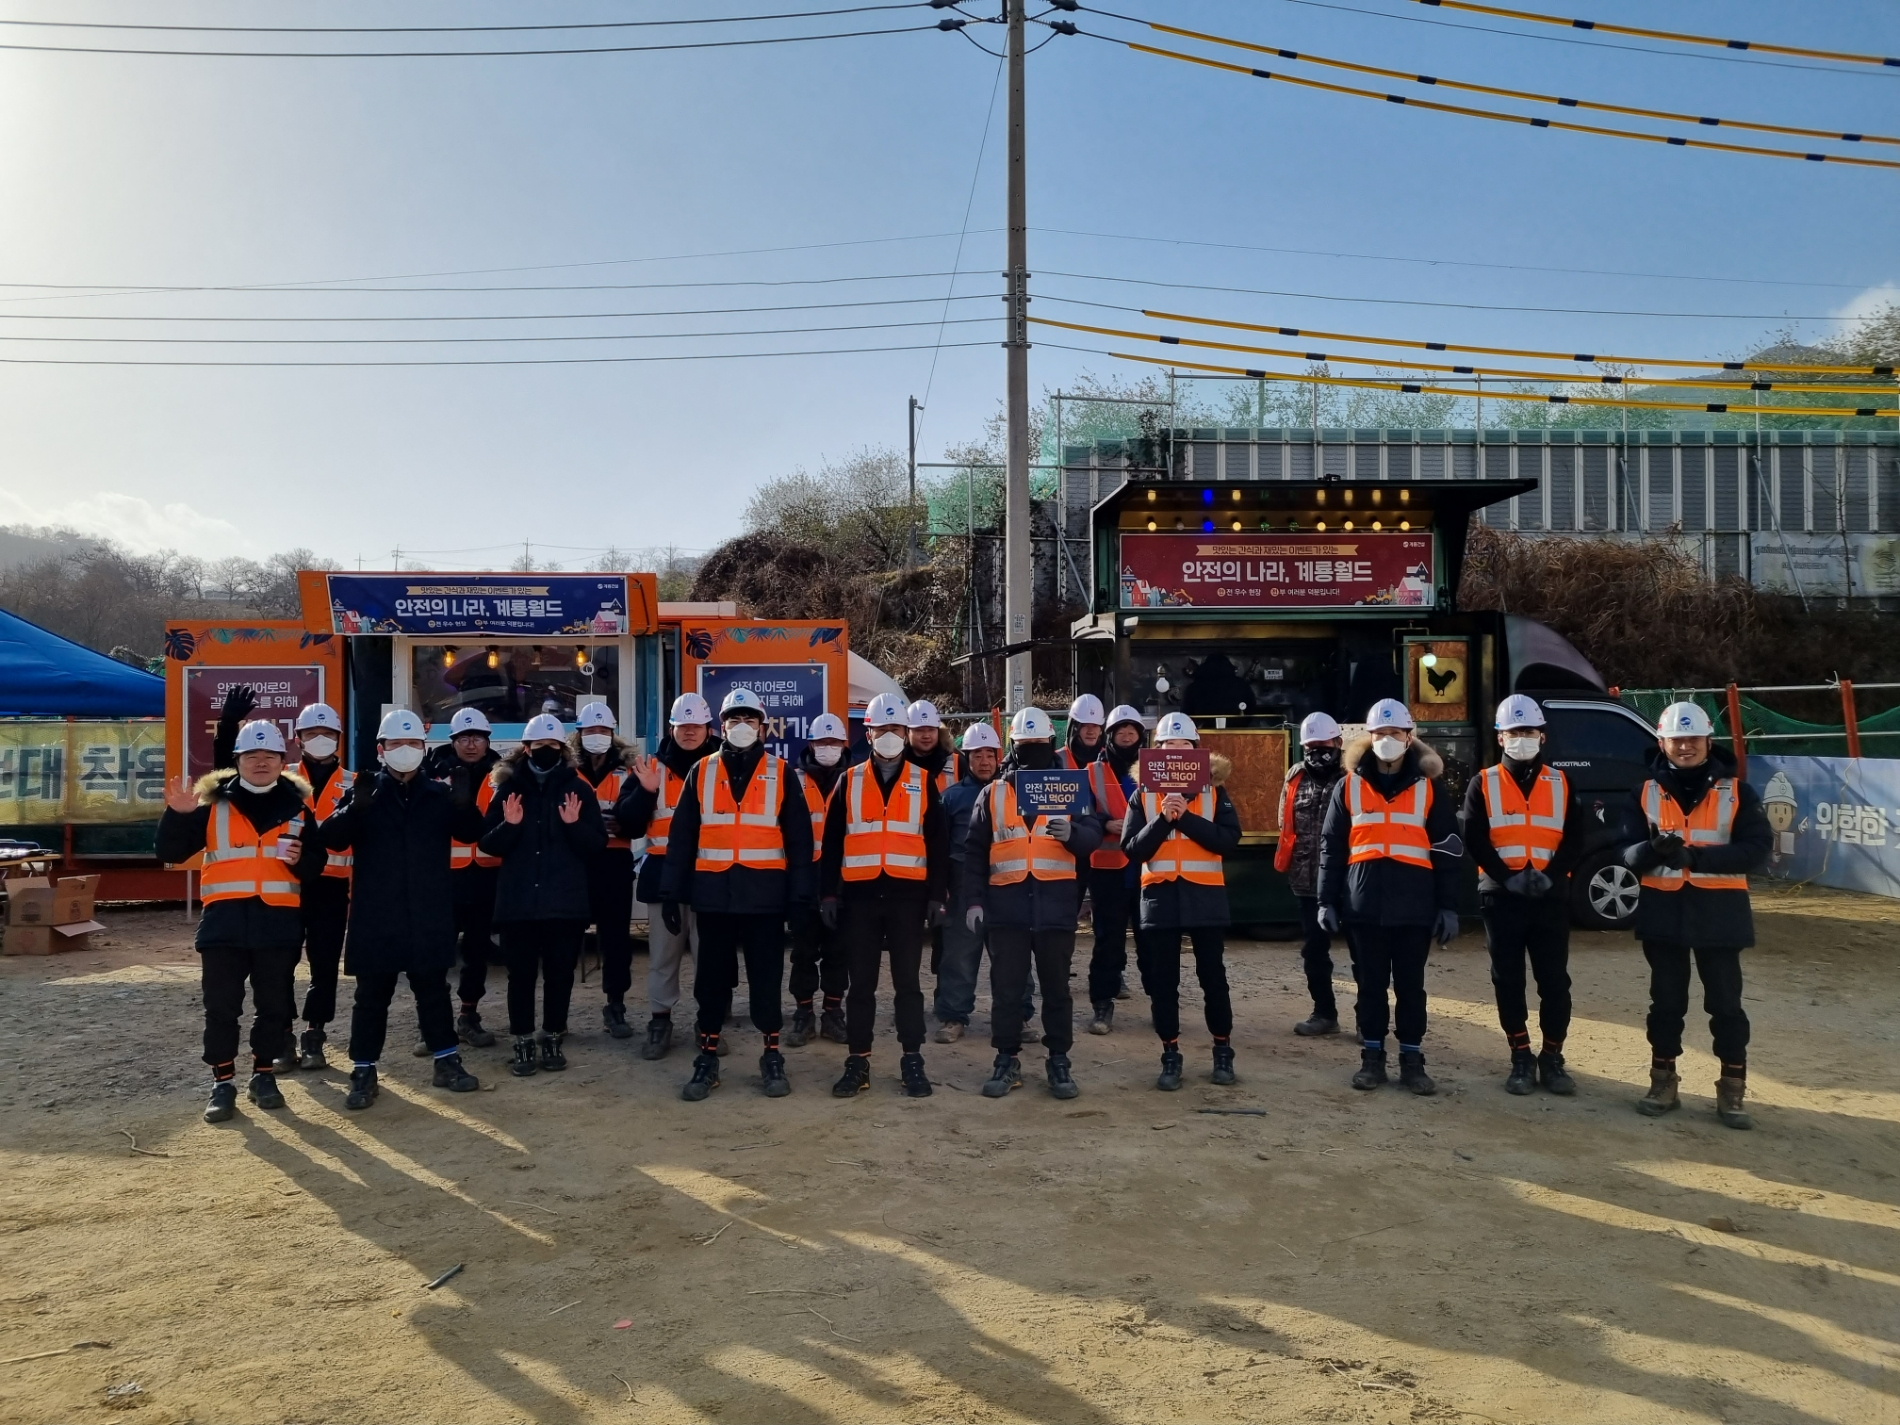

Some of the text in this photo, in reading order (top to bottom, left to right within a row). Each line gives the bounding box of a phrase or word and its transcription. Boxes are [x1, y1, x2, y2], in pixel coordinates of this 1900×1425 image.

[1212, 545, 1237, 555] 맛있는
[1238, 545, 1262, 555] 간식과
[1288, 545, 1321, 555] 이벤트가
[1322, 545, 1339, 555] 있는
[1182, 561, 1373, 583] 안전의 나라, 계룡월드
[420, 586, 443, 595] 맛있는
[444, 586, 466, 595] 간식과
[517, 586, 532, 595] 있는
[1234, 588, 1247, 597] 우수
[1248, 588, 1262, 597] 현장
[1287, 588, 1306, 597] 여러분
[1307, 587, 1340, 597] 덕분입니다!
[395, 598, 564, 617] 안전의 나라, 계룡월드
[243, 681, 291, 695] 히어로의
[754, 680, 797, 693] 히어로의
[273, 696, 298, 708] 위해
[781, 694, 804, 707] 위해
[1148, 761, 1201, 771] 안전 지키GO!
[1152, 772, 1197, 781] 간식 먹GO!
[1024, 782, 1079, 793] 안전 지키GO!
[1029, 794, 1075, 804] 간식 먹GO!
[1815, 802, 1886, 846] 위험한
